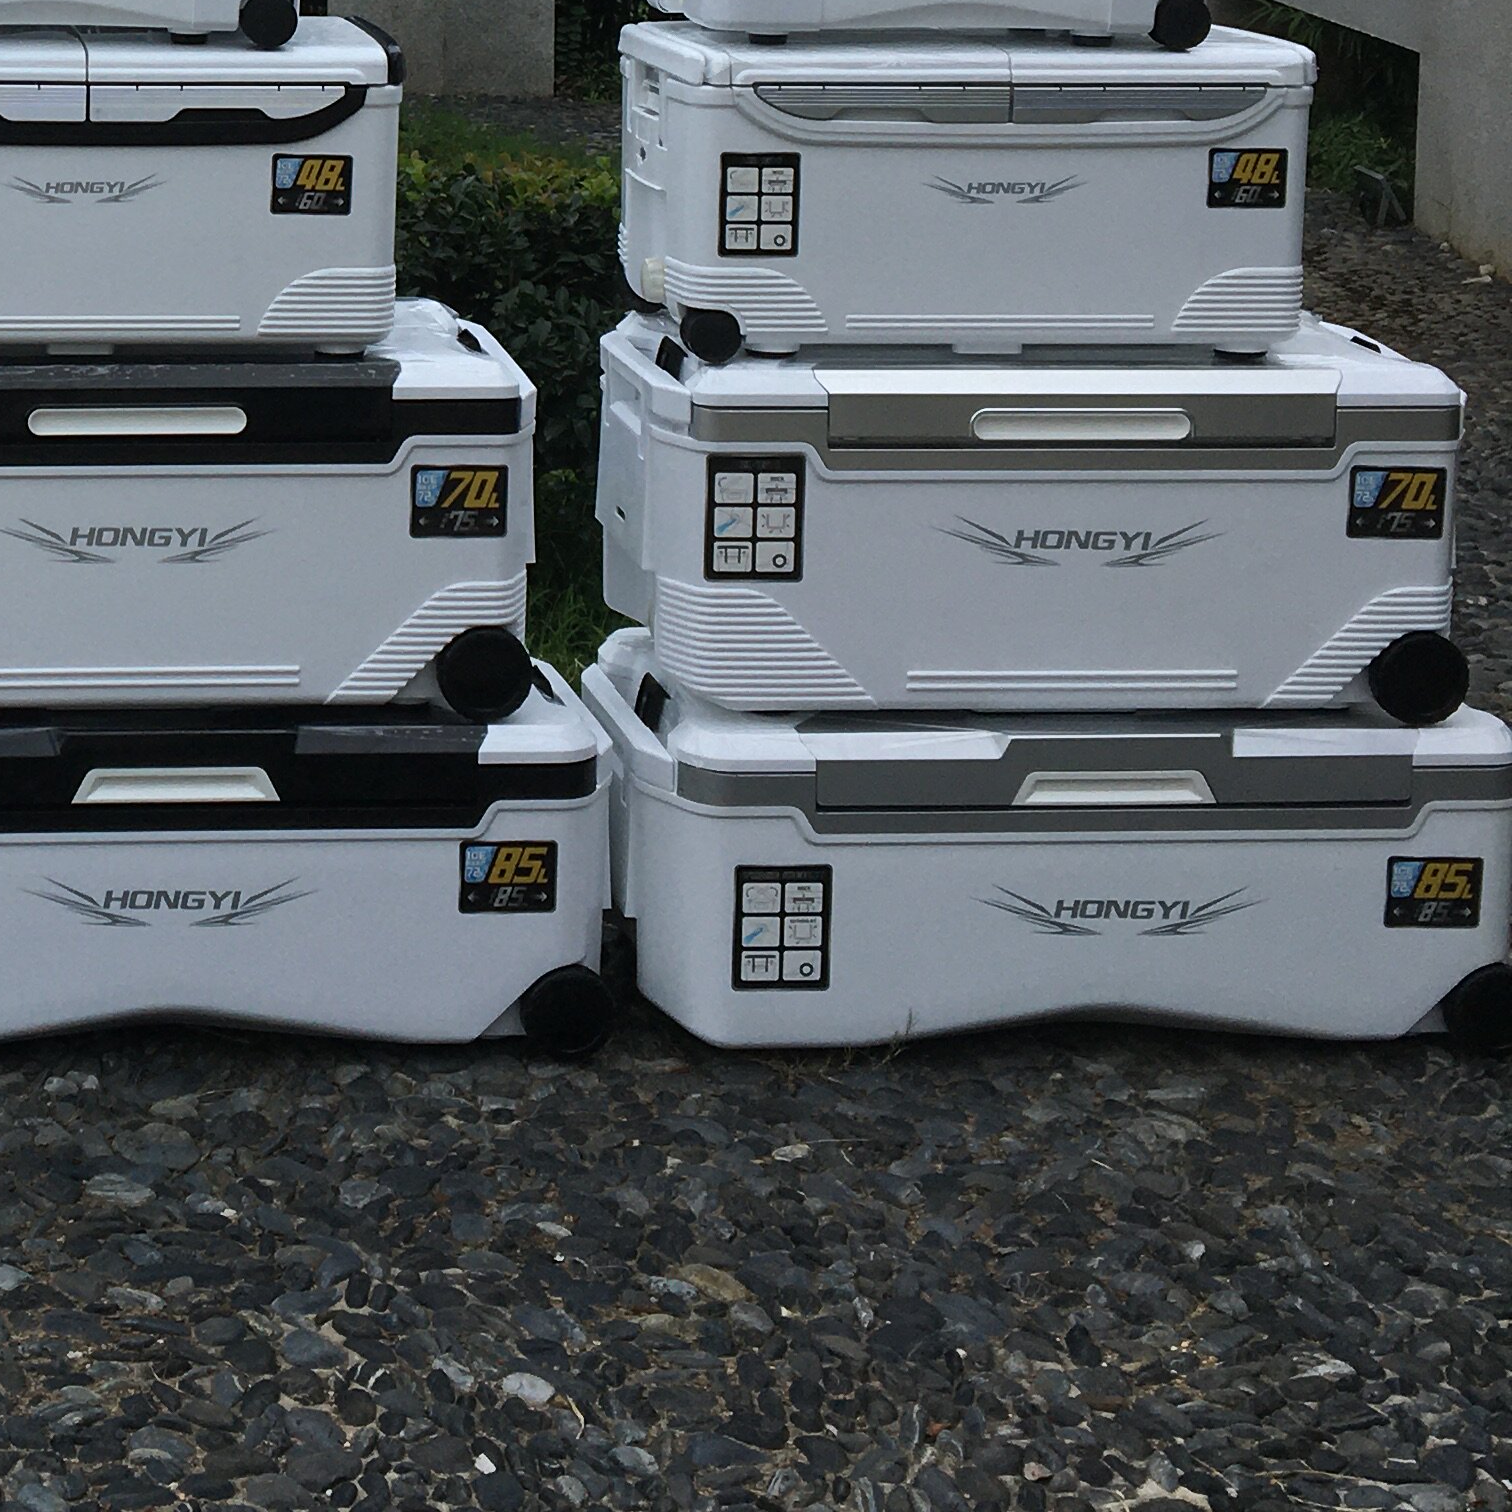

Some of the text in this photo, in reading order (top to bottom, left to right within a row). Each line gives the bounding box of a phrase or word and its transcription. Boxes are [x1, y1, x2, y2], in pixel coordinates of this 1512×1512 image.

[295, 159, 345, 190] 48L
[1231, 153, 1279, 184] 48L
[44, 181, 126, 193] HONGYI
[965, 182, 1047, 194] HONGYI
[441, 471, 500, 508] 70L
[1379, 473, 1437, 509] 70L
[68, 526, 208, 548] HONGYI
[1013, 528, 1152, 551] HONGYI
[488, 847, 548, 884] 85L
[1414, 863, 1474, 899] 85L
[102, 889, 243, 910] HONGYI
[1055, 899, 1191, 920] HONGYI
